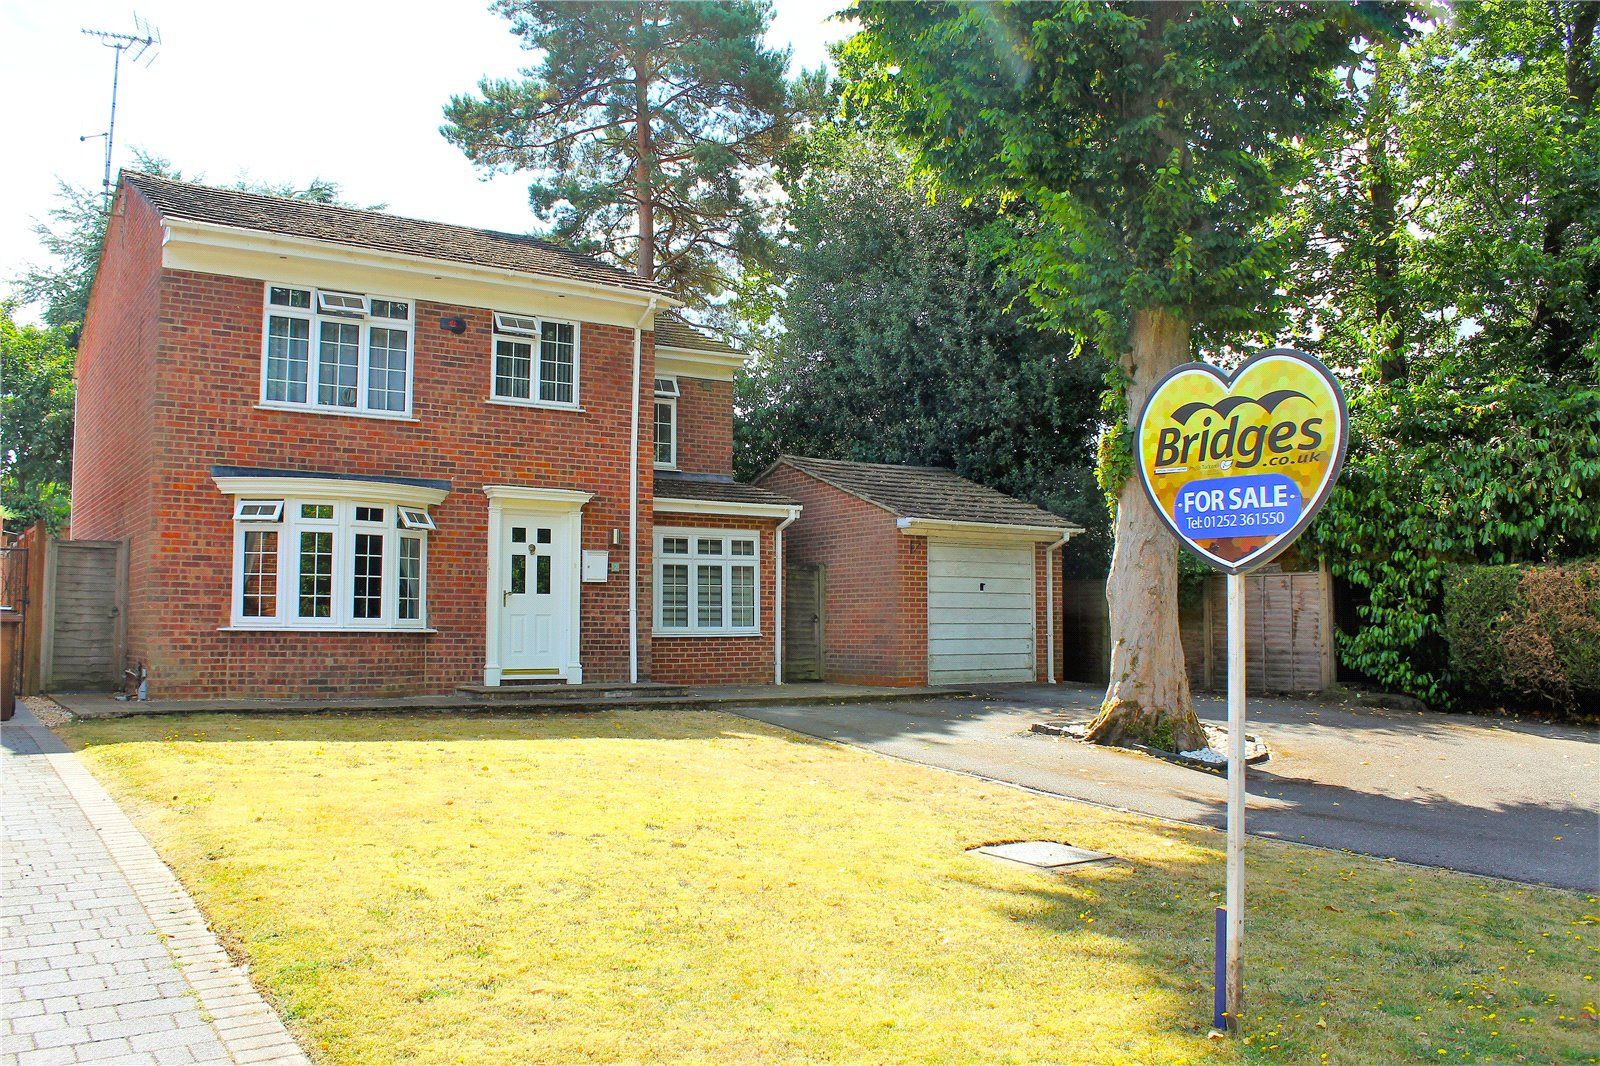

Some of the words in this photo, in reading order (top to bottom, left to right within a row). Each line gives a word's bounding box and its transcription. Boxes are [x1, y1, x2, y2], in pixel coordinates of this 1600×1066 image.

[1155, 415, 1323, 468] Bridges
[1262, 451, 1320, 467] .co.uk
[1183, 489, 1225, 513] FOR
[1228, 484, 1288, 510] SALE
[1186, 516, 1203, 529] Tel:
[1203, 514, 1238, 528] 01252
[1239, 511, 1285, 526] 361550
